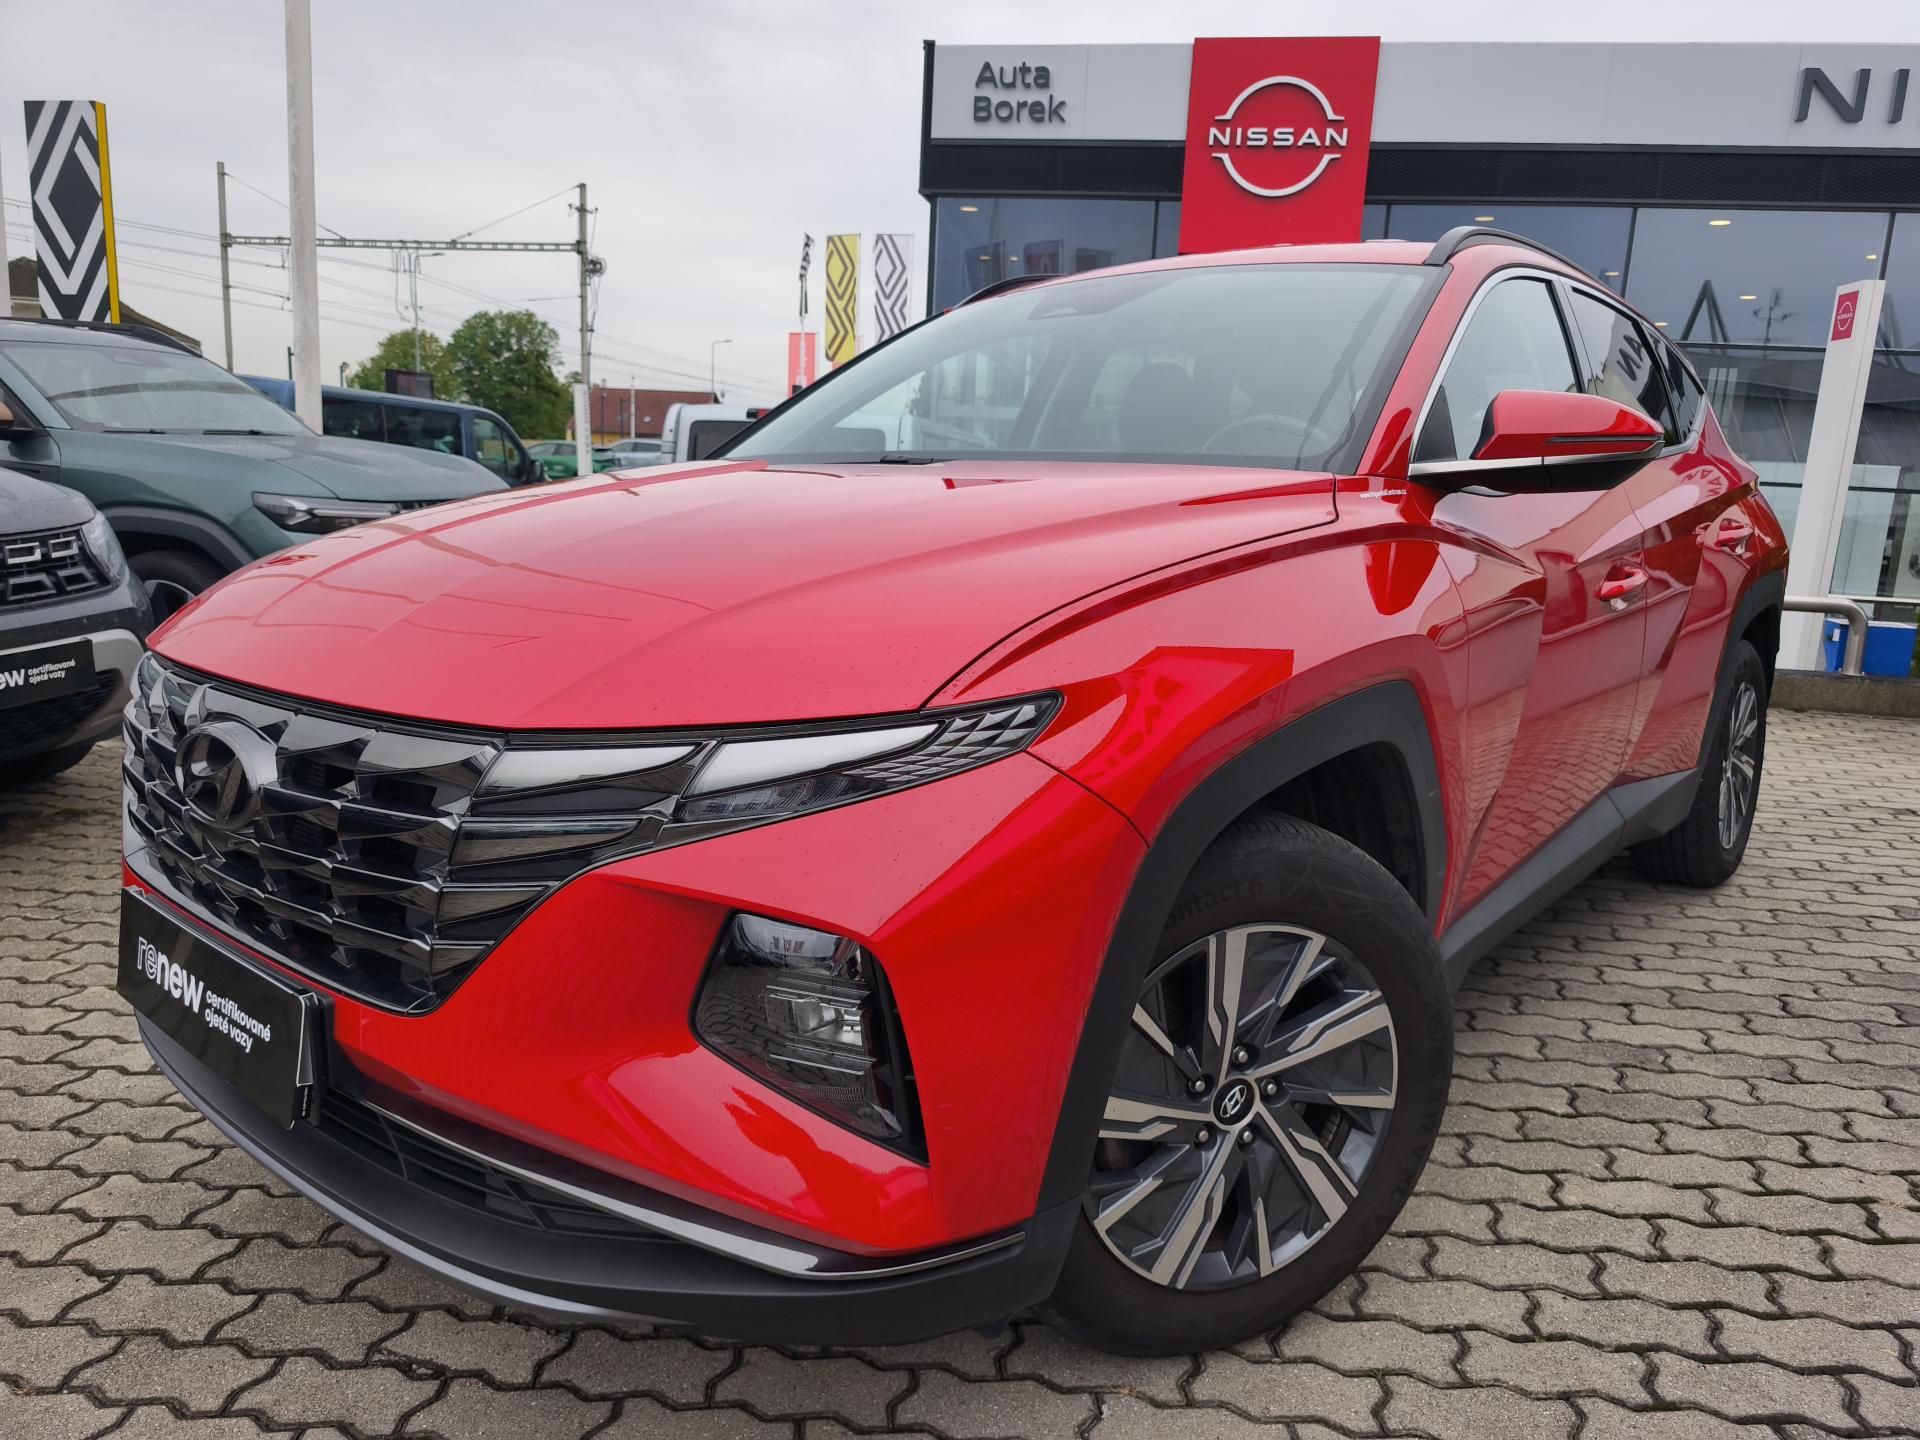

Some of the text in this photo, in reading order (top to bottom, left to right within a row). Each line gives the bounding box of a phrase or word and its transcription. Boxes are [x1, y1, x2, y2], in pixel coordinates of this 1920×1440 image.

[974, 61, 1050, 89] Auta
[973, 94, 1067, 122] Borek
[1794, 67, 1911, 124] NI
[1208, 127, 1349, 147] NISSAN
[1836, 312, 1853, 320] NISSAN
[28, 659, 75, 675] certifikované
[48, 670, 66, 679] vozy
[137, 935, 272, 1042] renew certifikované
[204, 1008, 253, 1053] ojeté vozy
